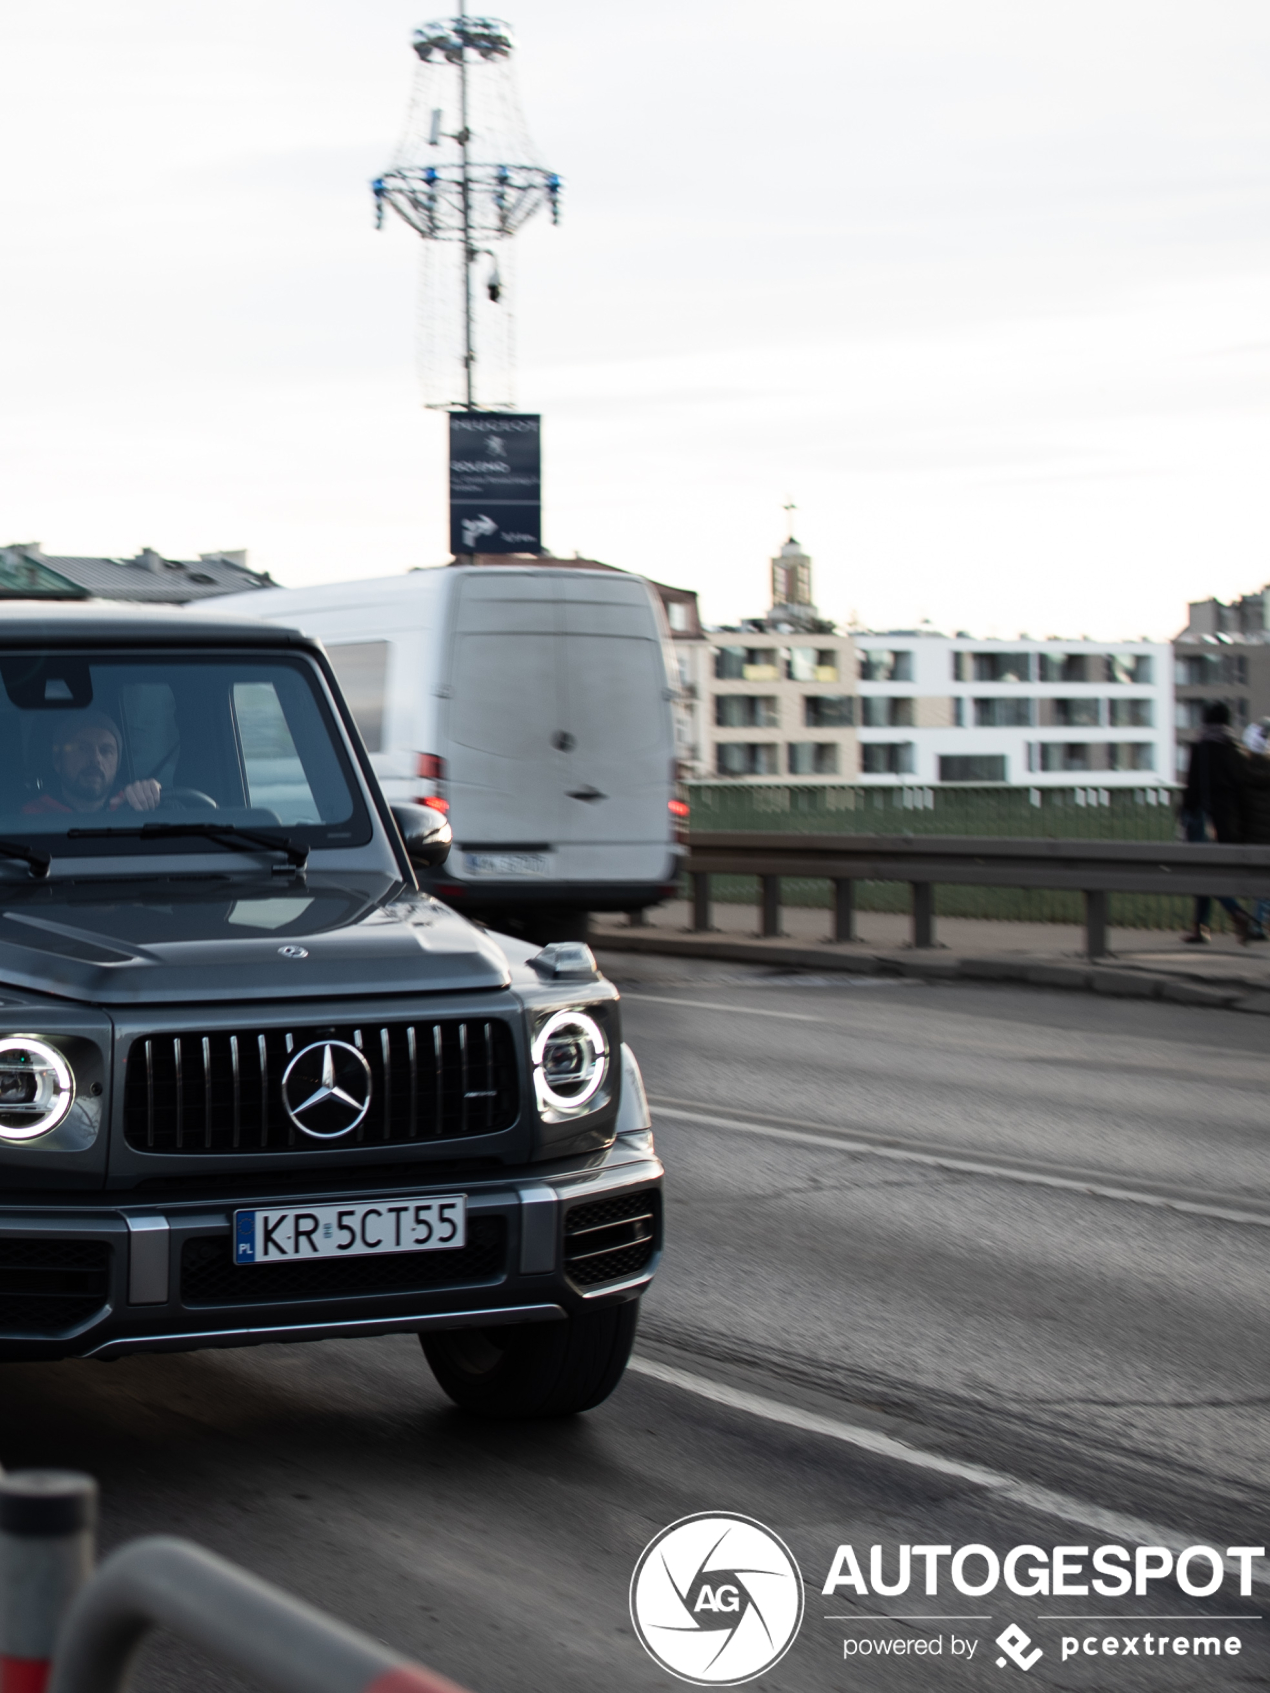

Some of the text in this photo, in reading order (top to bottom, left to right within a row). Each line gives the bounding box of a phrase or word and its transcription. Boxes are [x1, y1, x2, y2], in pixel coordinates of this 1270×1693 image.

[238, 1202, 458, 1256] PL KR 5CT55
